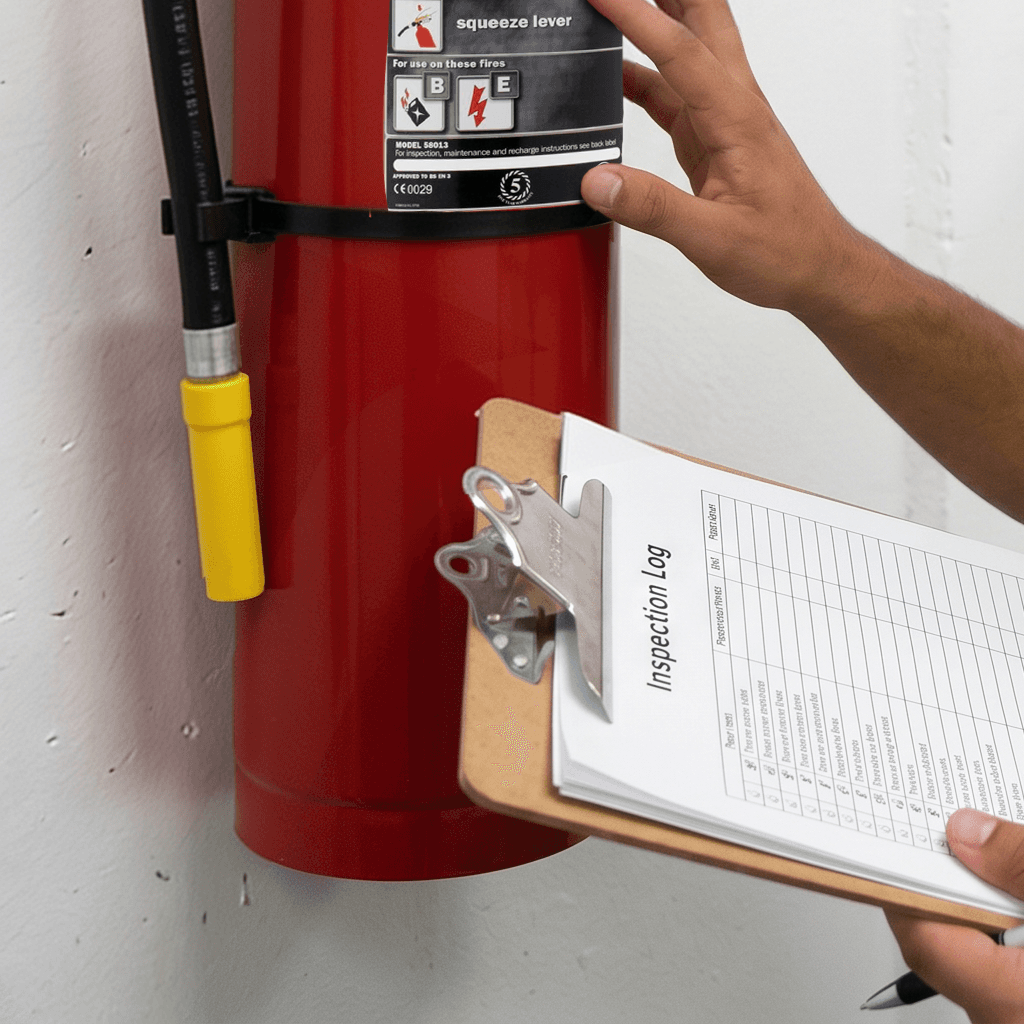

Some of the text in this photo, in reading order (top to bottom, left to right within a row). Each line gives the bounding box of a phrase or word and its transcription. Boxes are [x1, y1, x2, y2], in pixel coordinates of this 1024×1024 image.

[456, 14, 572, 31] squeeze lever
[392, 59, 506, 69] For use on these fires
[430, 77, 445, 94] B
[497, 76, 511, 92] E
[395, 141, 449, 149] MODEL 58013
[406, 149, 442, 157] inspection,
[444, 149, 491, 157] maintenance
[508, 146, 540, 155] recharge
[541, 143, 579, 152] instructions
[590, 140, 604, 148] back
[605, 138, 617, 146] label
[510, 178, 521, 193] 5
[641, 544, 677, 692] Inspection Log
